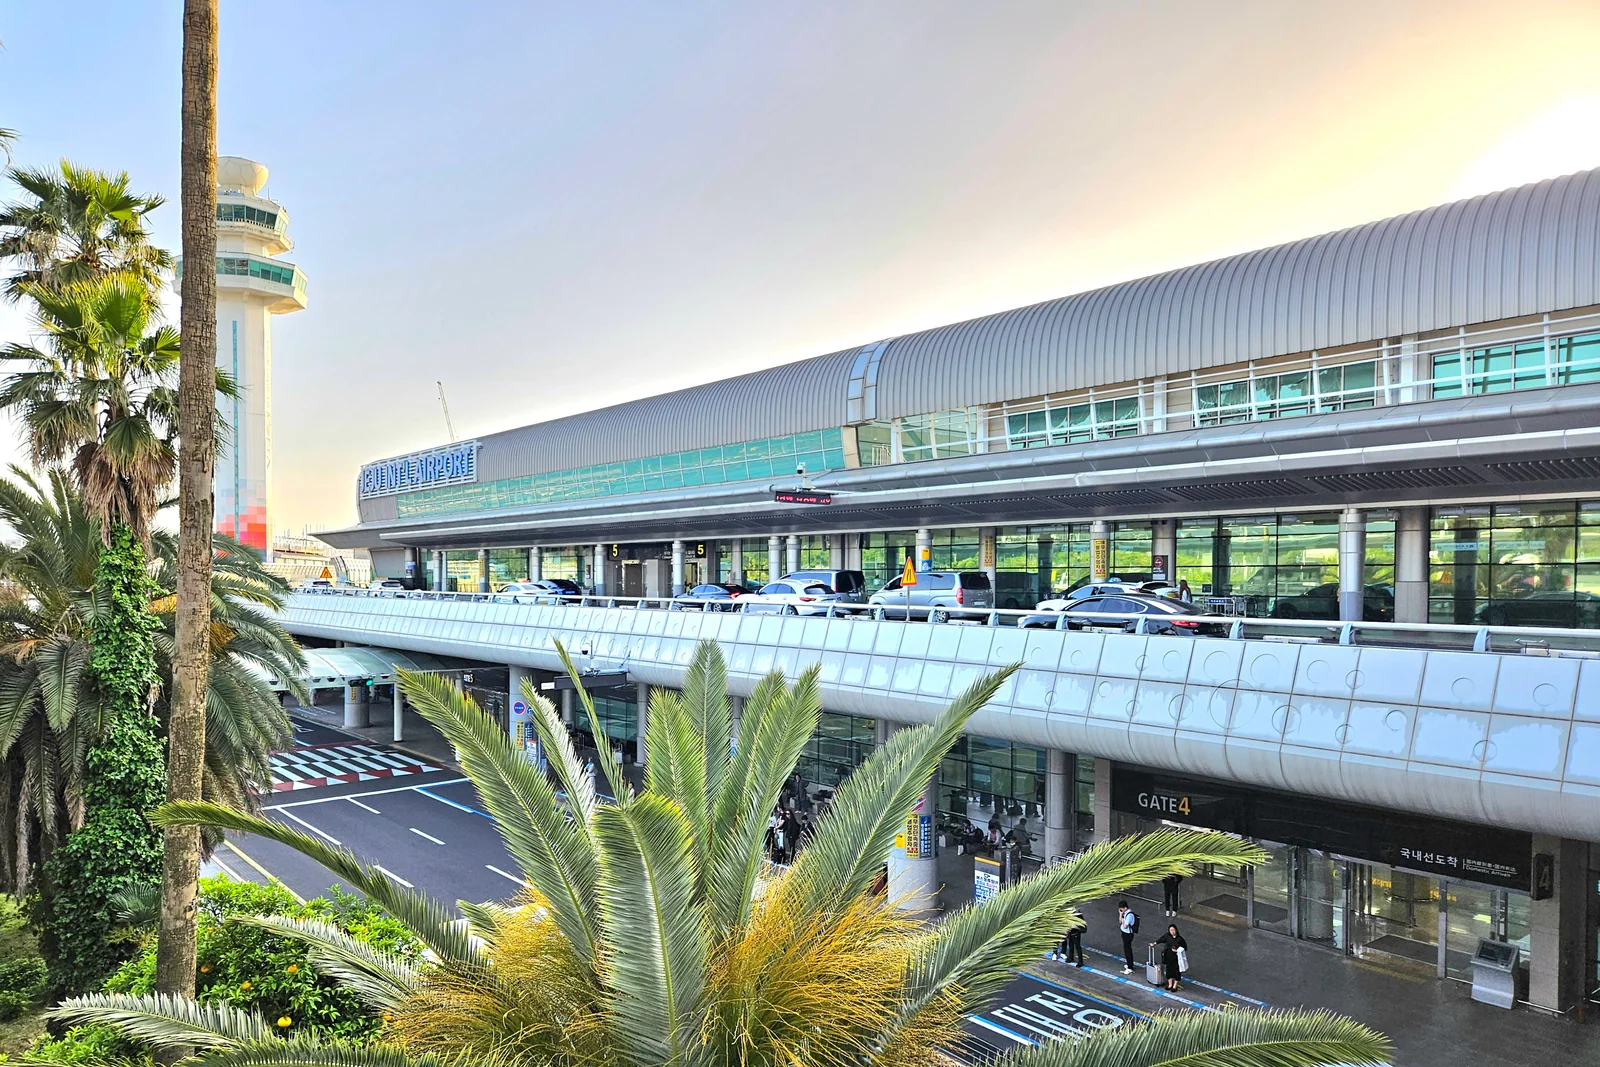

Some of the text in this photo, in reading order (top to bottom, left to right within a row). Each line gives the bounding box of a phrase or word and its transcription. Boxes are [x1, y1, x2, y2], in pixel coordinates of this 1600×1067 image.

[412, 447, 473, 483] AIRPORT
[612, 544, 619, 557] 5
[697, 544, 705, 555] 5
[1400, 848, 1458, 868] 국내선도착
